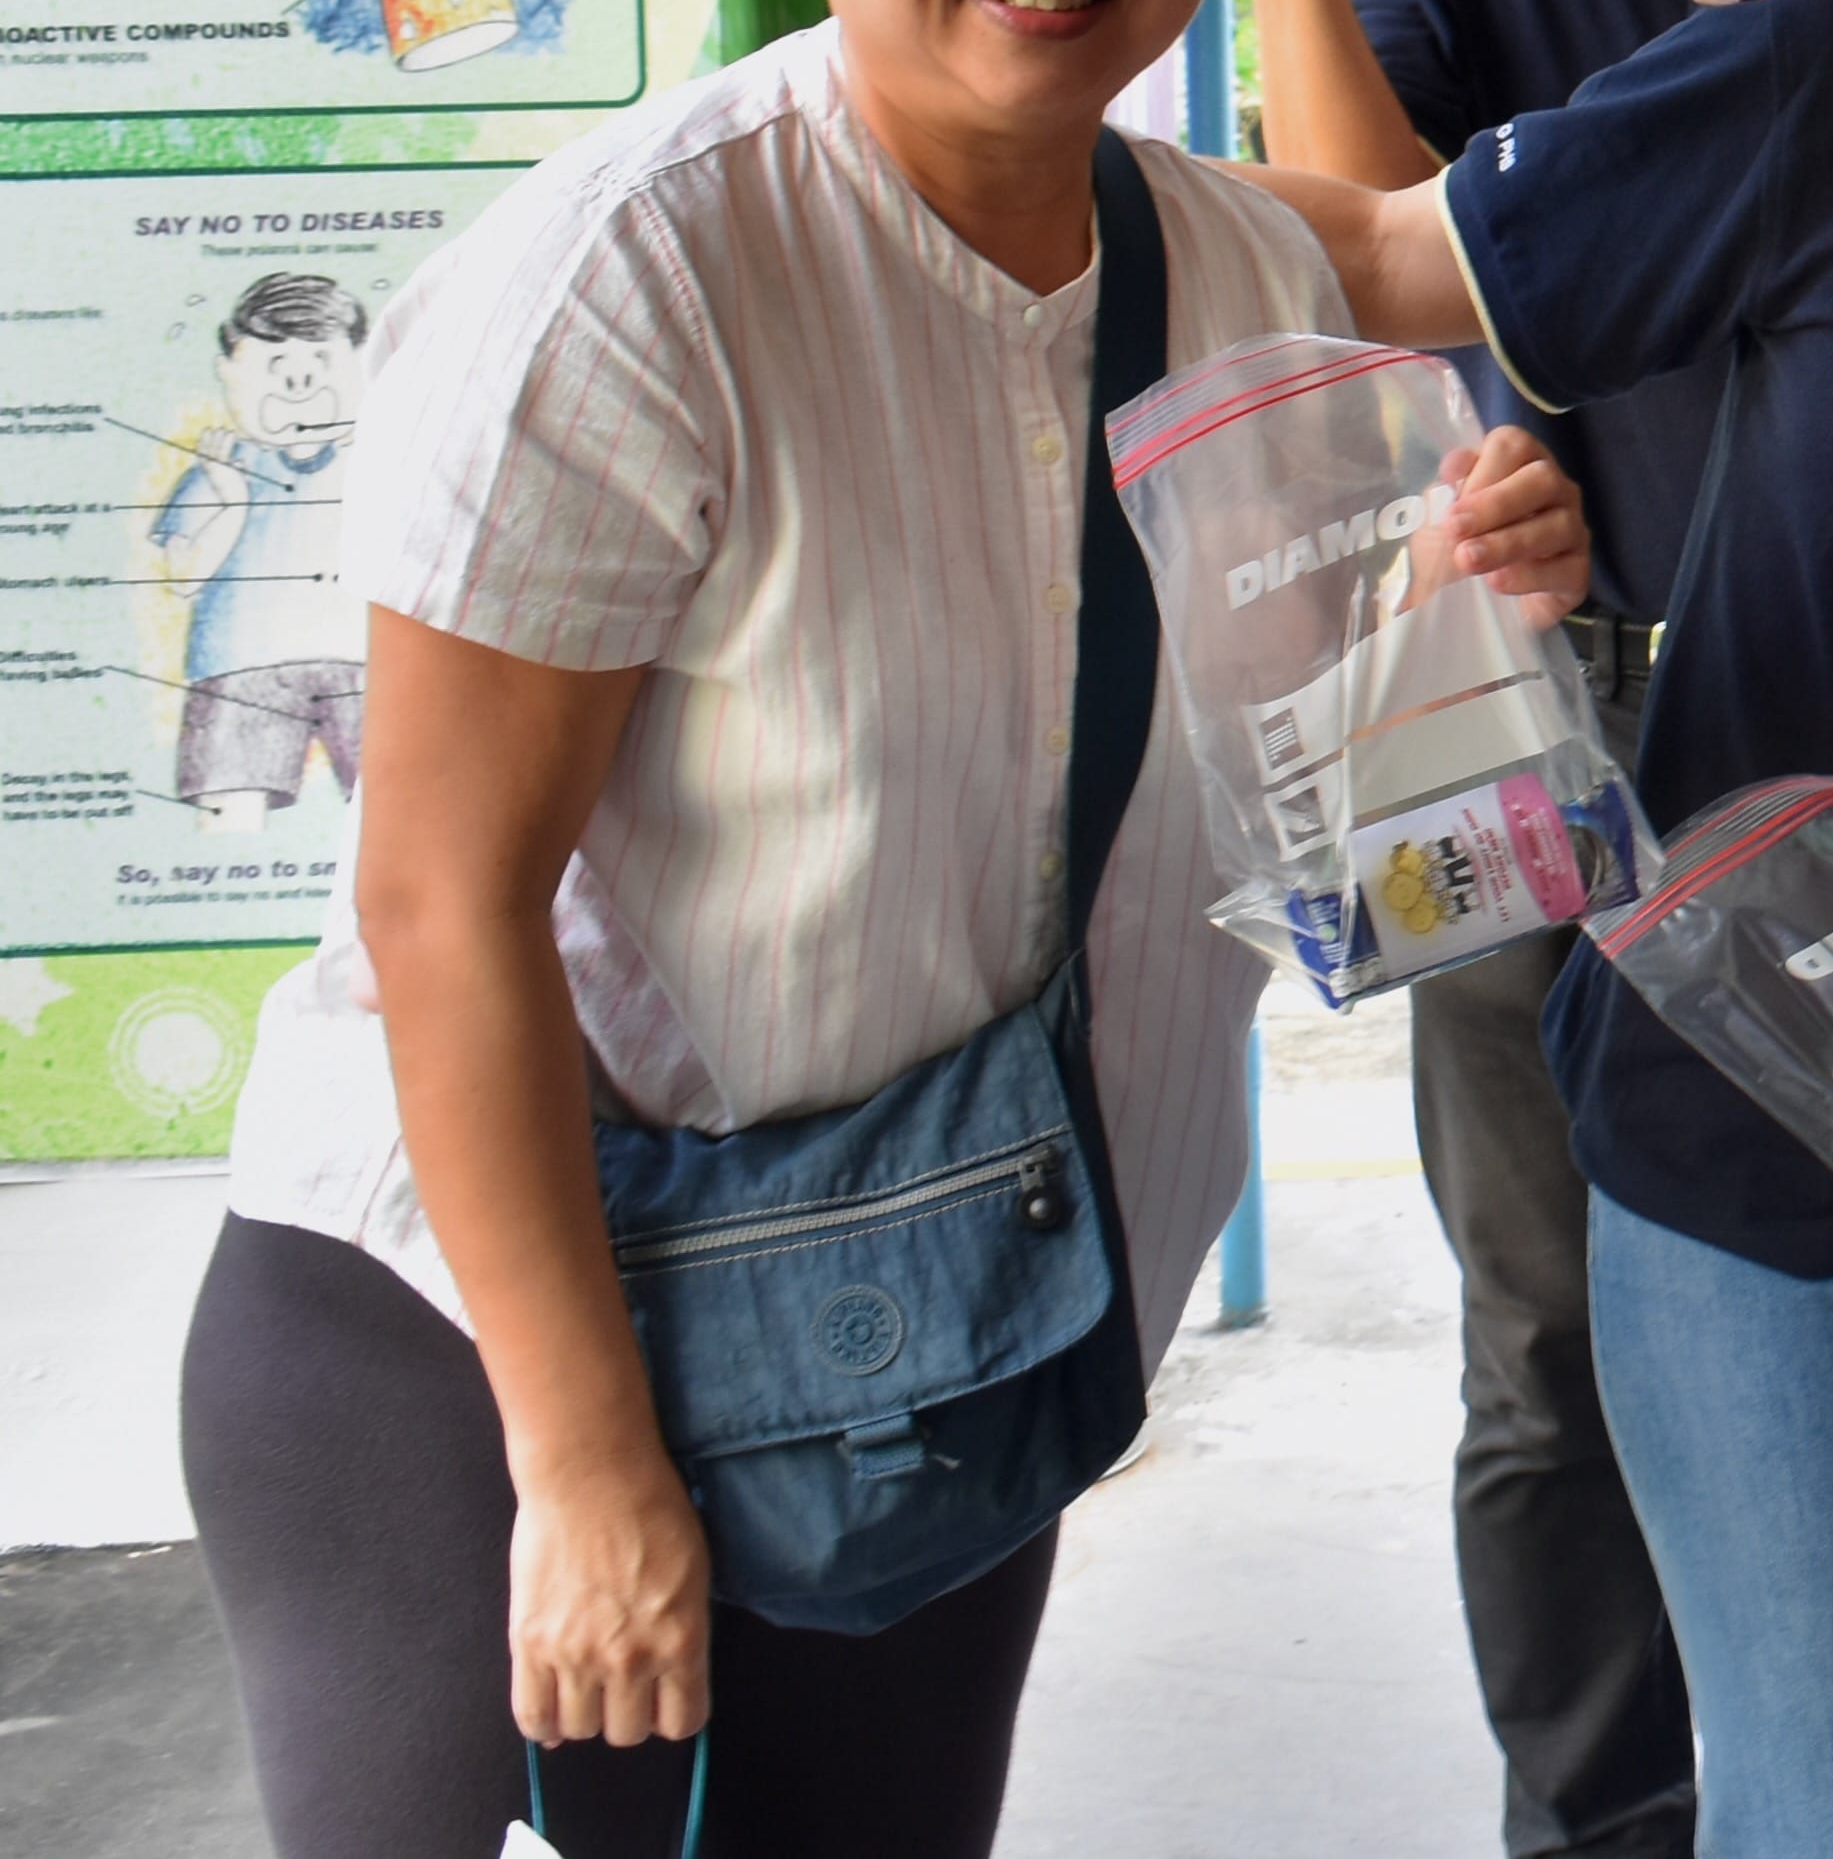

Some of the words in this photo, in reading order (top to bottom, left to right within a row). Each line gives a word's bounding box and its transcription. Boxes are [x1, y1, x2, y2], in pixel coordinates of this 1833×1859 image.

[0, 25, 119, 45] OACTIVE
[127, 20, 292, 41] COMPOUNDS
[135, 216, 191, 236] SAY
[200, 214, 242, 235] NO
[254, 213, 291, 234] TO
[301, 209, 446, 233] DISEASES
[1225, 483, 1464, 611] DIAMON
[116, 863, 162, 888] So,
[170, 864, 222, 887] say
[227, 863, 263, 880] no
[270, 859, 300, 879] to
